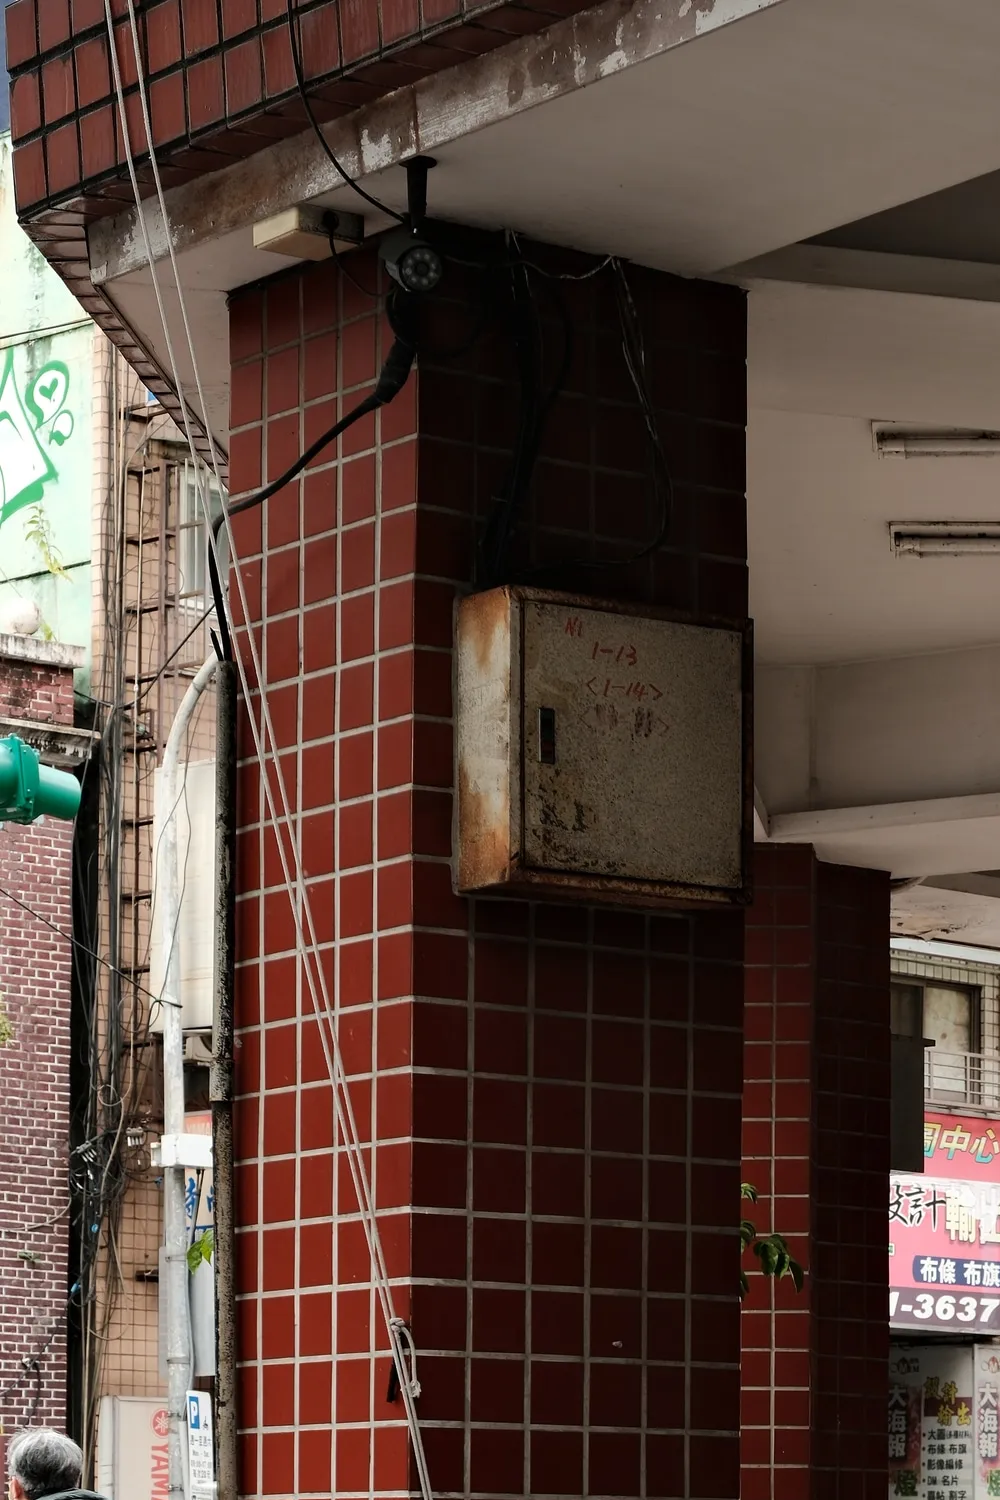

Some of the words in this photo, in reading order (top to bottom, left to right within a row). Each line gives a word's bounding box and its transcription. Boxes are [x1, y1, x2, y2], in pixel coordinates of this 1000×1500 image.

[920, 1256, 956, 1285] 布條
[963, 1260, 1000, 1288] 布旗
[978, 1382, 999, 1458] 大海報
[941, 1475, 959, 1486] 名片
